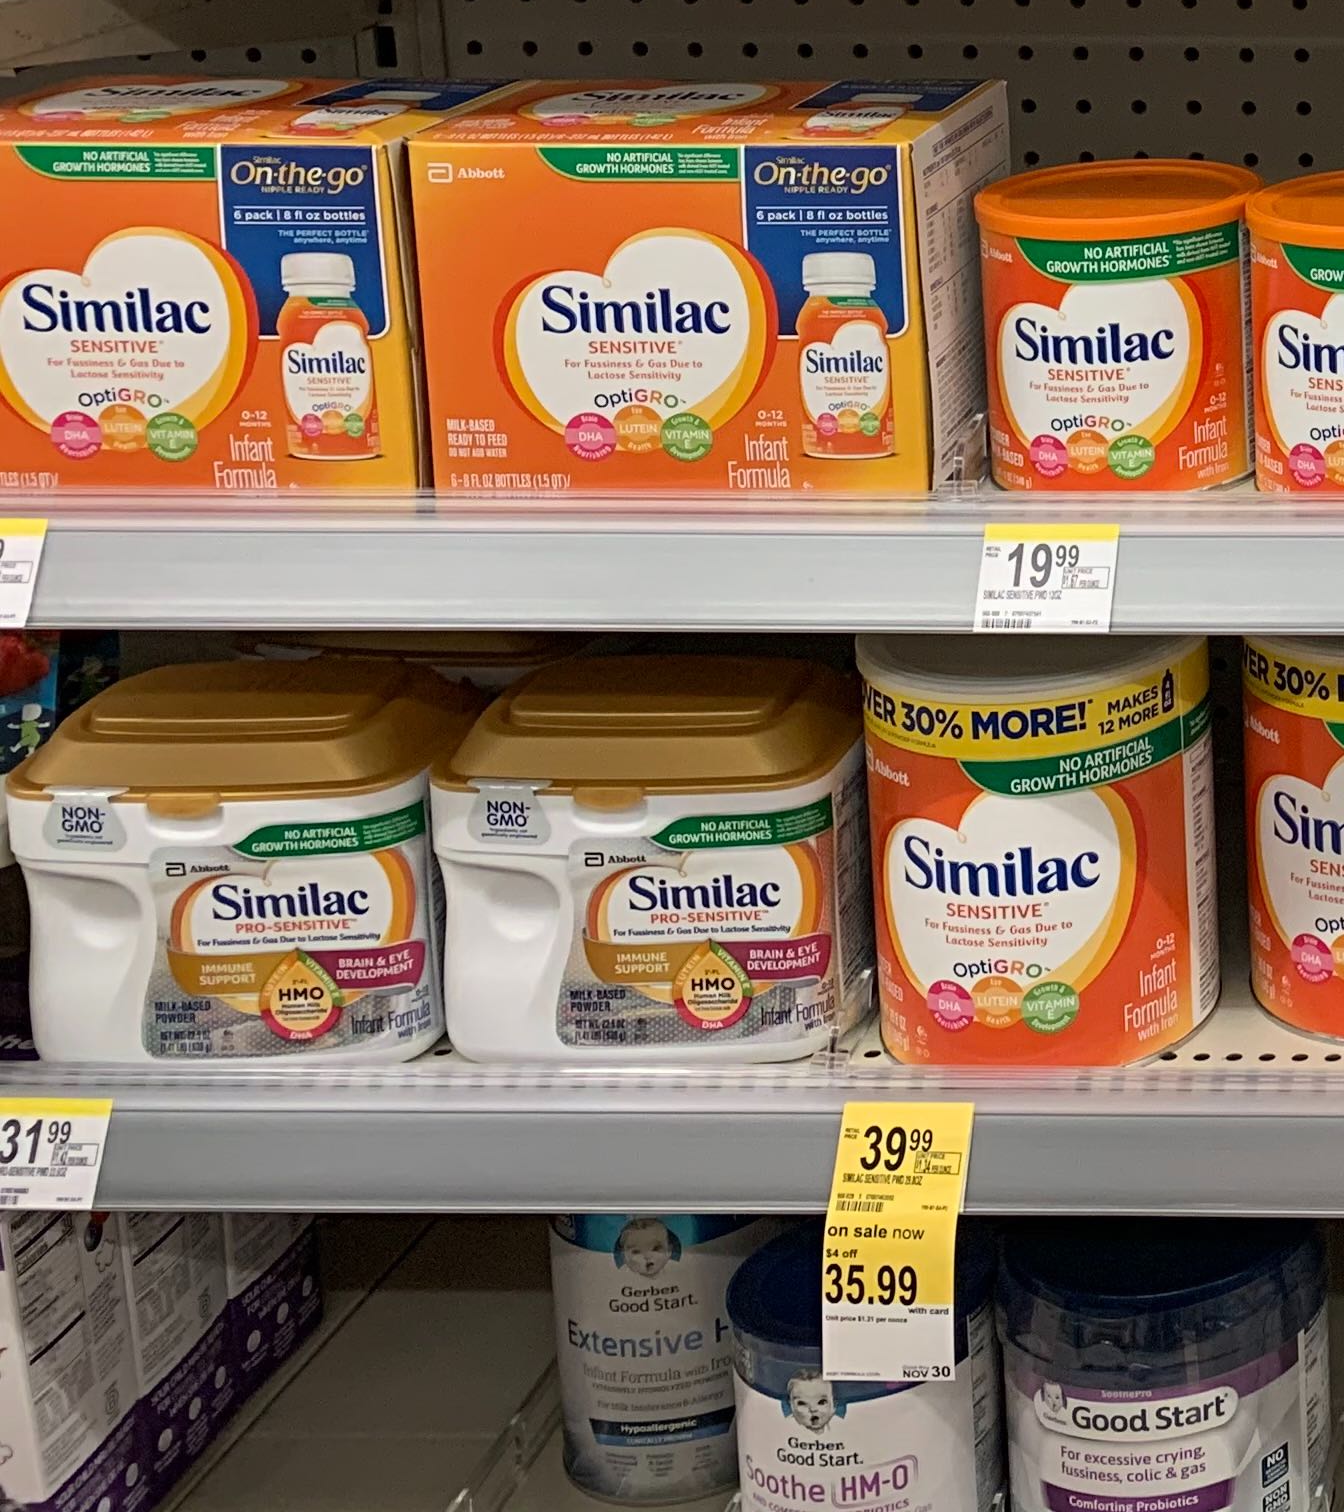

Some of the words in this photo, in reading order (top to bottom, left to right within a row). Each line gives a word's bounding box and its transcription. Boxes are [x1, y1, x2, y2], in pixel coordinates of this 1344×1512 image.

[457, 166, 505, 181] Abbott
[1047, 260, 1097, 274] GROWTH
[1084, 248, 1102, 260] NO
[1105, 243, 1169, 258] ARTIFICIAL
[21, 285, 211, 336] Similac
[541, 285, 731, 336] Similac
[588, 340, 677, 353] SENSITIVE
[1015, 318, 1175, 365] Similac
[619, 422, 657, 435] LUTEIN
[901, 702, 963, 740] 30%
[903, 836, 1101, 897] Similac
[212, 885, 370, 920] Similac
[235, 918, 351, 933] PRO-SENSITIVE
[825, 1264, 918, 1309] 35.99
[1071, 1405, 1147, 1433] Good
[1155, 1395, 1226, 1428] Start
